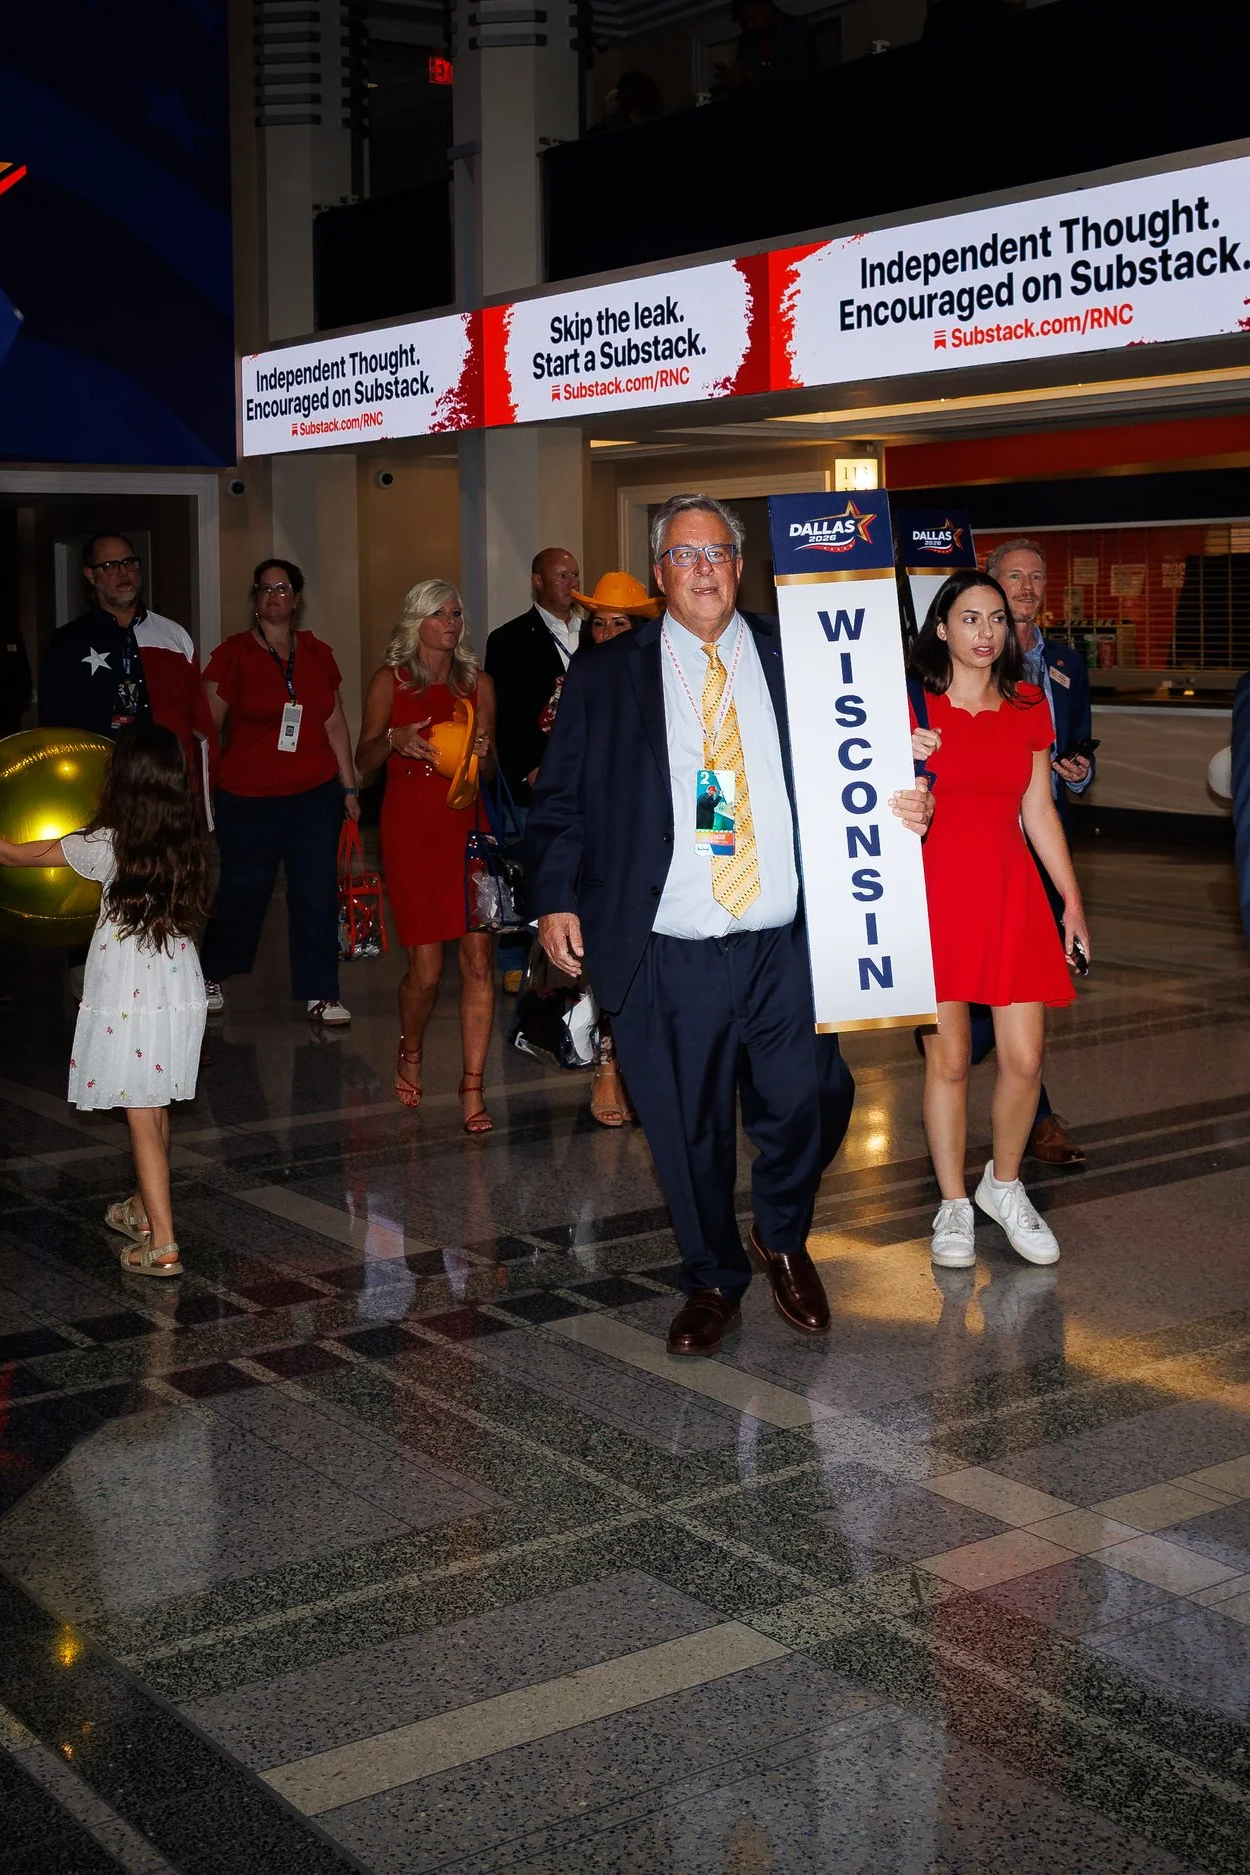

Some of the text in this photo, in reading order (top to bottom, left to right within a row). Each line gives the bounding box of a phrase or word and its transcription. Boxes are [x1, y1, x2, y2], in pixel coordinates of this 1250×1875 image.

[860, 196, 1220, 290] Independent Thought.
[839, 236, 1250, 332] Encouraged on Substack.
[550, 295, 685, 346] Skip the leak.
[951, 303, 1134, 349] Substack.com/RNC
[256, 343, 421, 393] Independent Thought.
[532, 327, 707, 381] Start a Substack.
[246, 370, 435, 422] Encouraged on Substack.
[563, 366, 691, 401] Substack.com/RNC
[299, 411, 384, 437] Substack.com/RNC
[789, 518, 856, 538] DALLAS
[808, 533, 837, 544] 2026
[912, 530, 952, 541] DALLAS
[700, 771, 710, 784] 2
[817, 607, 894, 991] WISCONSIN
